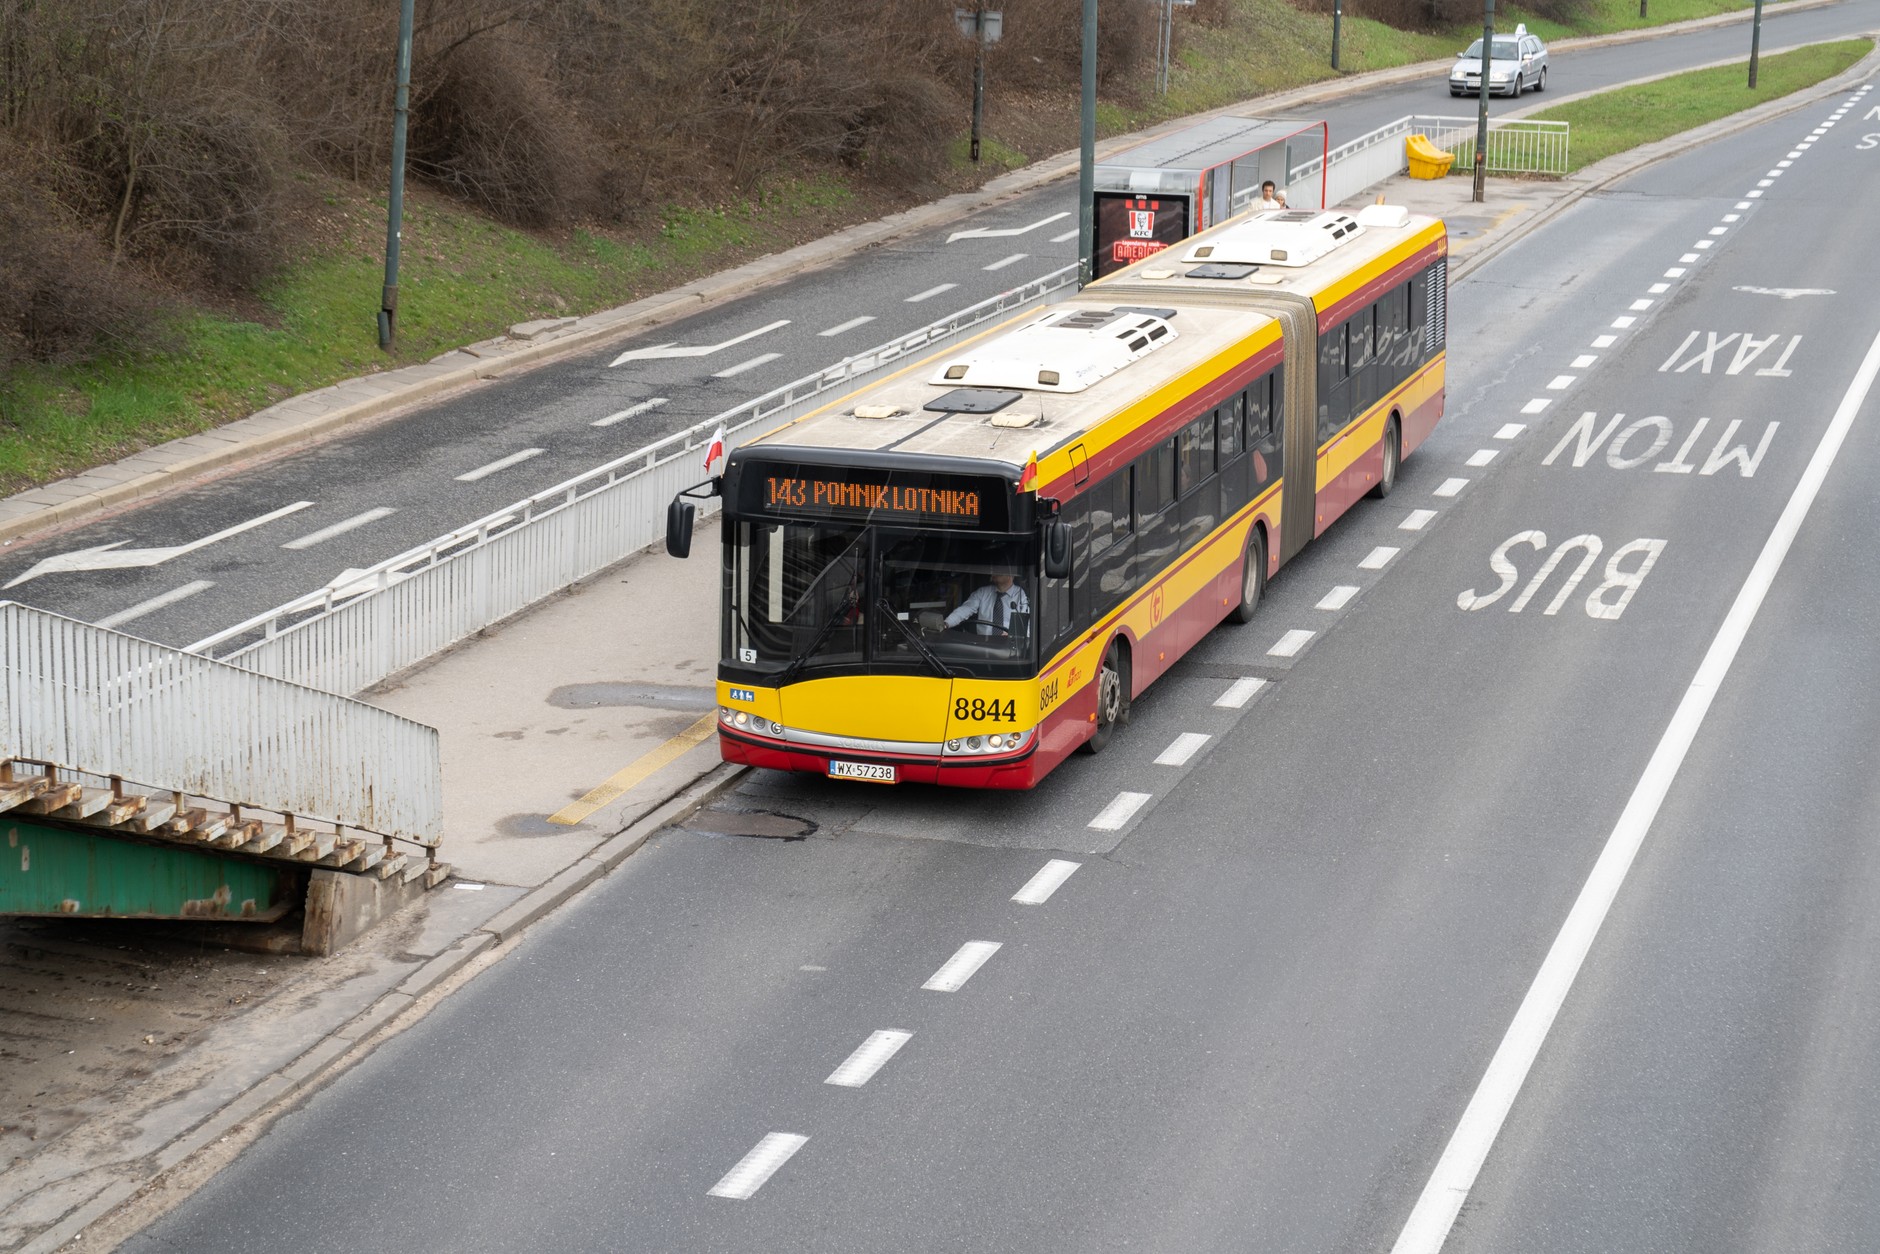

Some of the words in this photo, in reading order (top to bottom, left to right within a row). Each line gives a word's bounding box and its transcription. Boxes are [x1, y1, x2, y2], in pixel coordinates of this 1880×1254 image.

[1658, 331, 1803, 377] TAXI
[1541, 411, 1780, 477] MTON
[767, 477, 806, 506] 143
[813, 480, 889, 509] POMNIK
[893, 486, 979, 516] LOTNIKA
[1456, 529, 1668, 620] BUS
[745, 651, 752, 661] 5
[954, 697, 1017, 722] 8844
[1040, 677, 1059, 711] 8844
